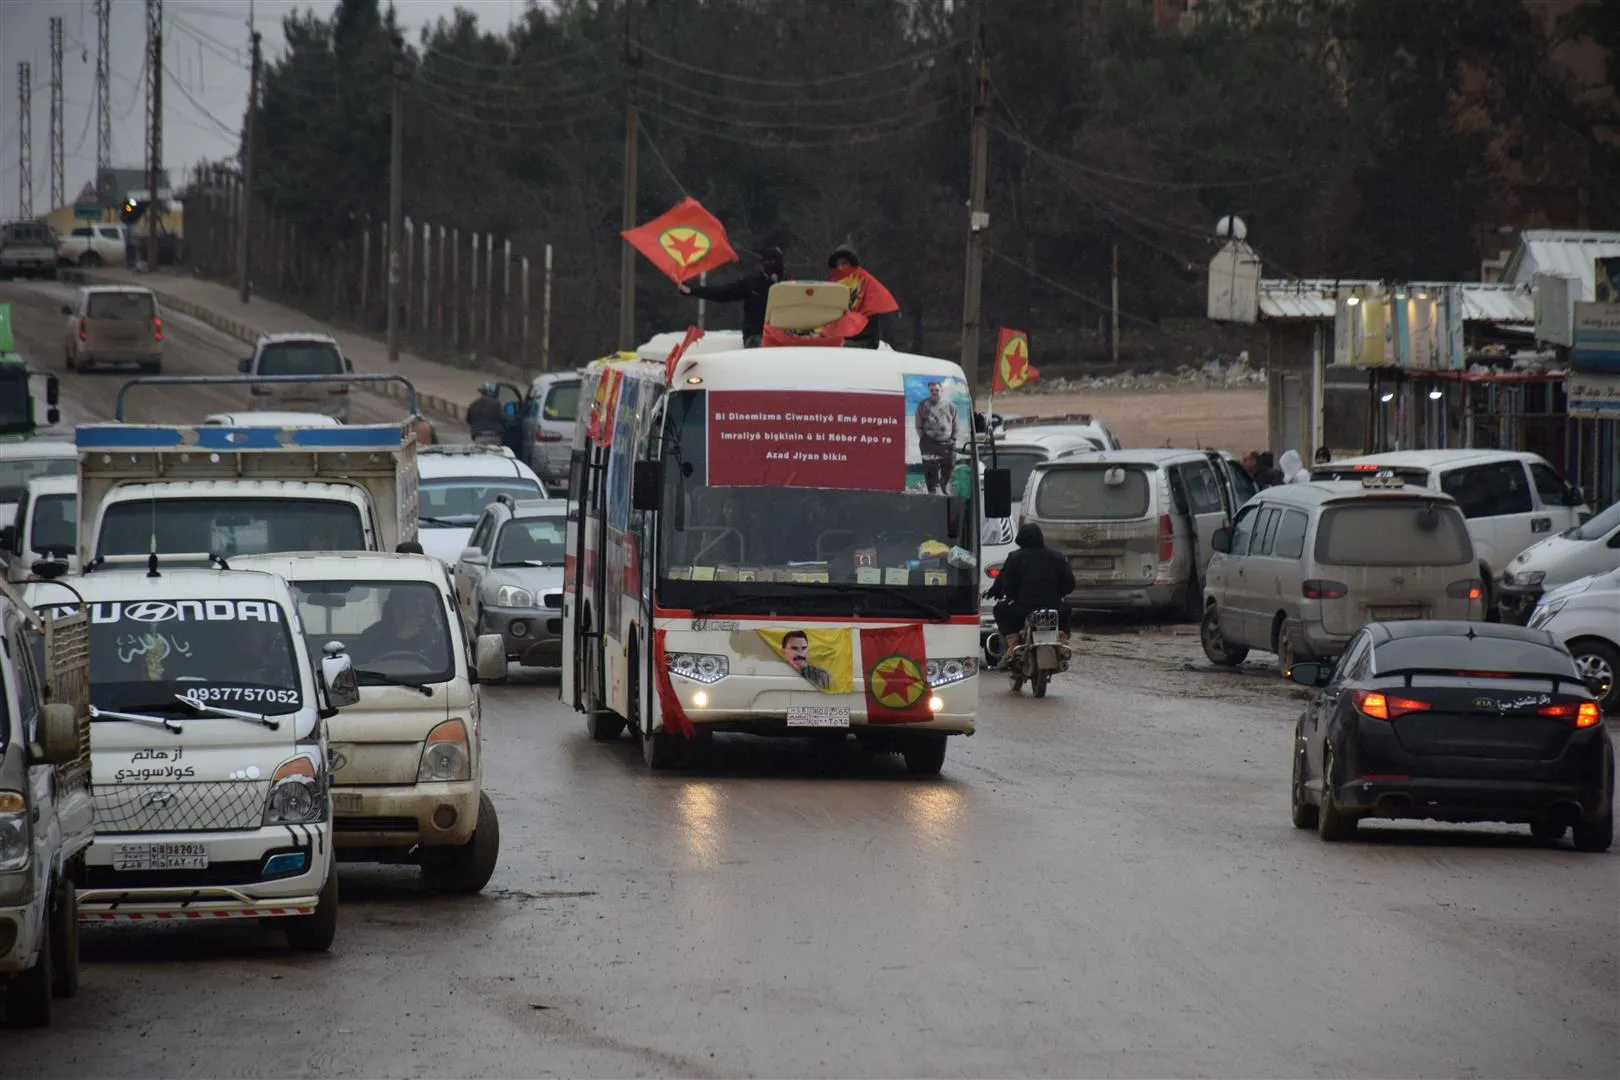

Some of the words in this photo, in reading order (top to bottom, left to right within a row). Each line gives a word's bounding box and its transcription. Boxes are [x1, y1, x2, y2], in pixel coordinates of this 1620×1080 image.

[715, 412, 725, 421] Bi
[861, 415, 898, 426] pergala
[816, 432, 825, 441] bi
[860, 434, 879, 445] Apo
[882, 436, 892, 444] re
[766, 451, 790, 460] Azad
[793, 451, 820, 462] Jiyan
[822, 452, 847, 462] bikin
[187, 688, 299, 705] 0937757052
[131, 748, 169, 763] هاتم
[114, 766, 195, 783] كولاسويدي
